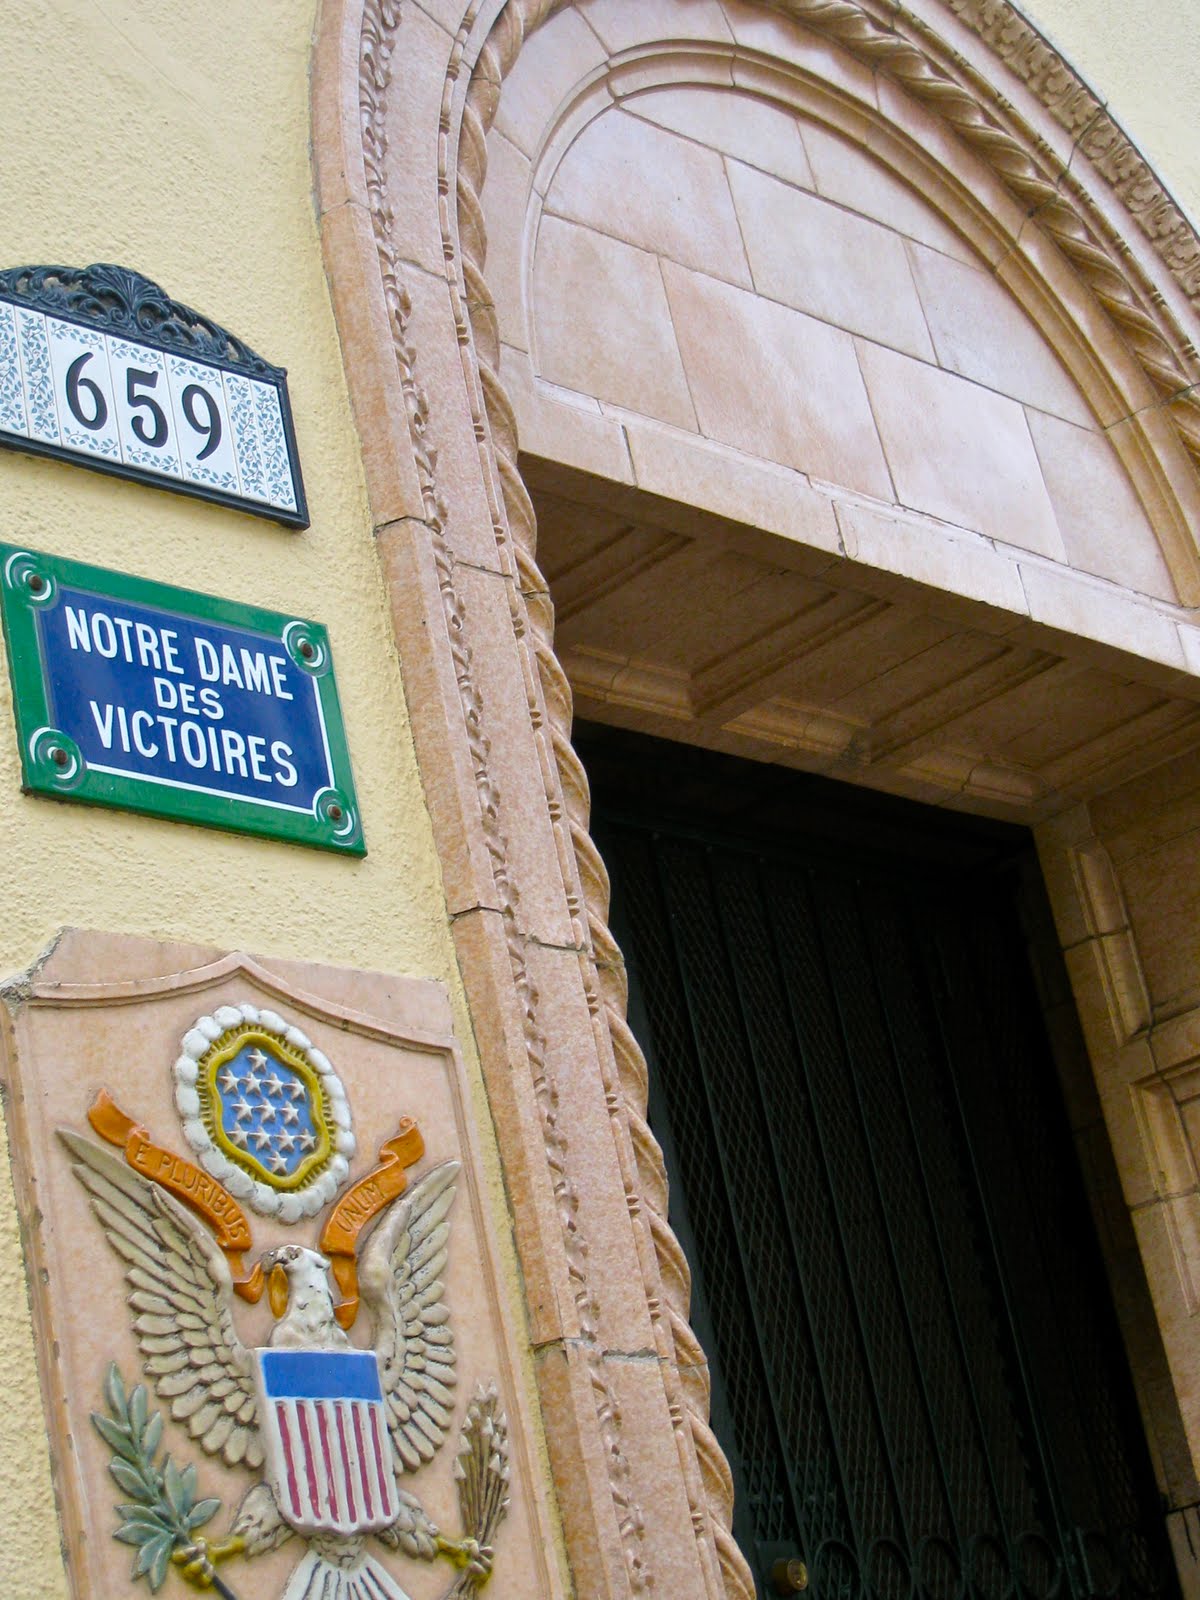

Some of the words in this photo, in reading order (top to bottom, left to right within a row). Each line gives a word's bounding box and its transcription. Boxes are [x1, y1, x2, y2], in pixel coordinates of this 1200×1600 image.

[65, 352, 222, 460] 659
[64, 605, 186, 676] NOTRE
[194, 637, 295, 701] DAME
[153, 676, 225, 721] DES
[89, 700, 300, 789] VICTOIRES
[135, 1142, 151, 1165] E
[158, 1154, 248, 1240] PLURIBUS
[335, 1181, 387, 1233] UNUM
